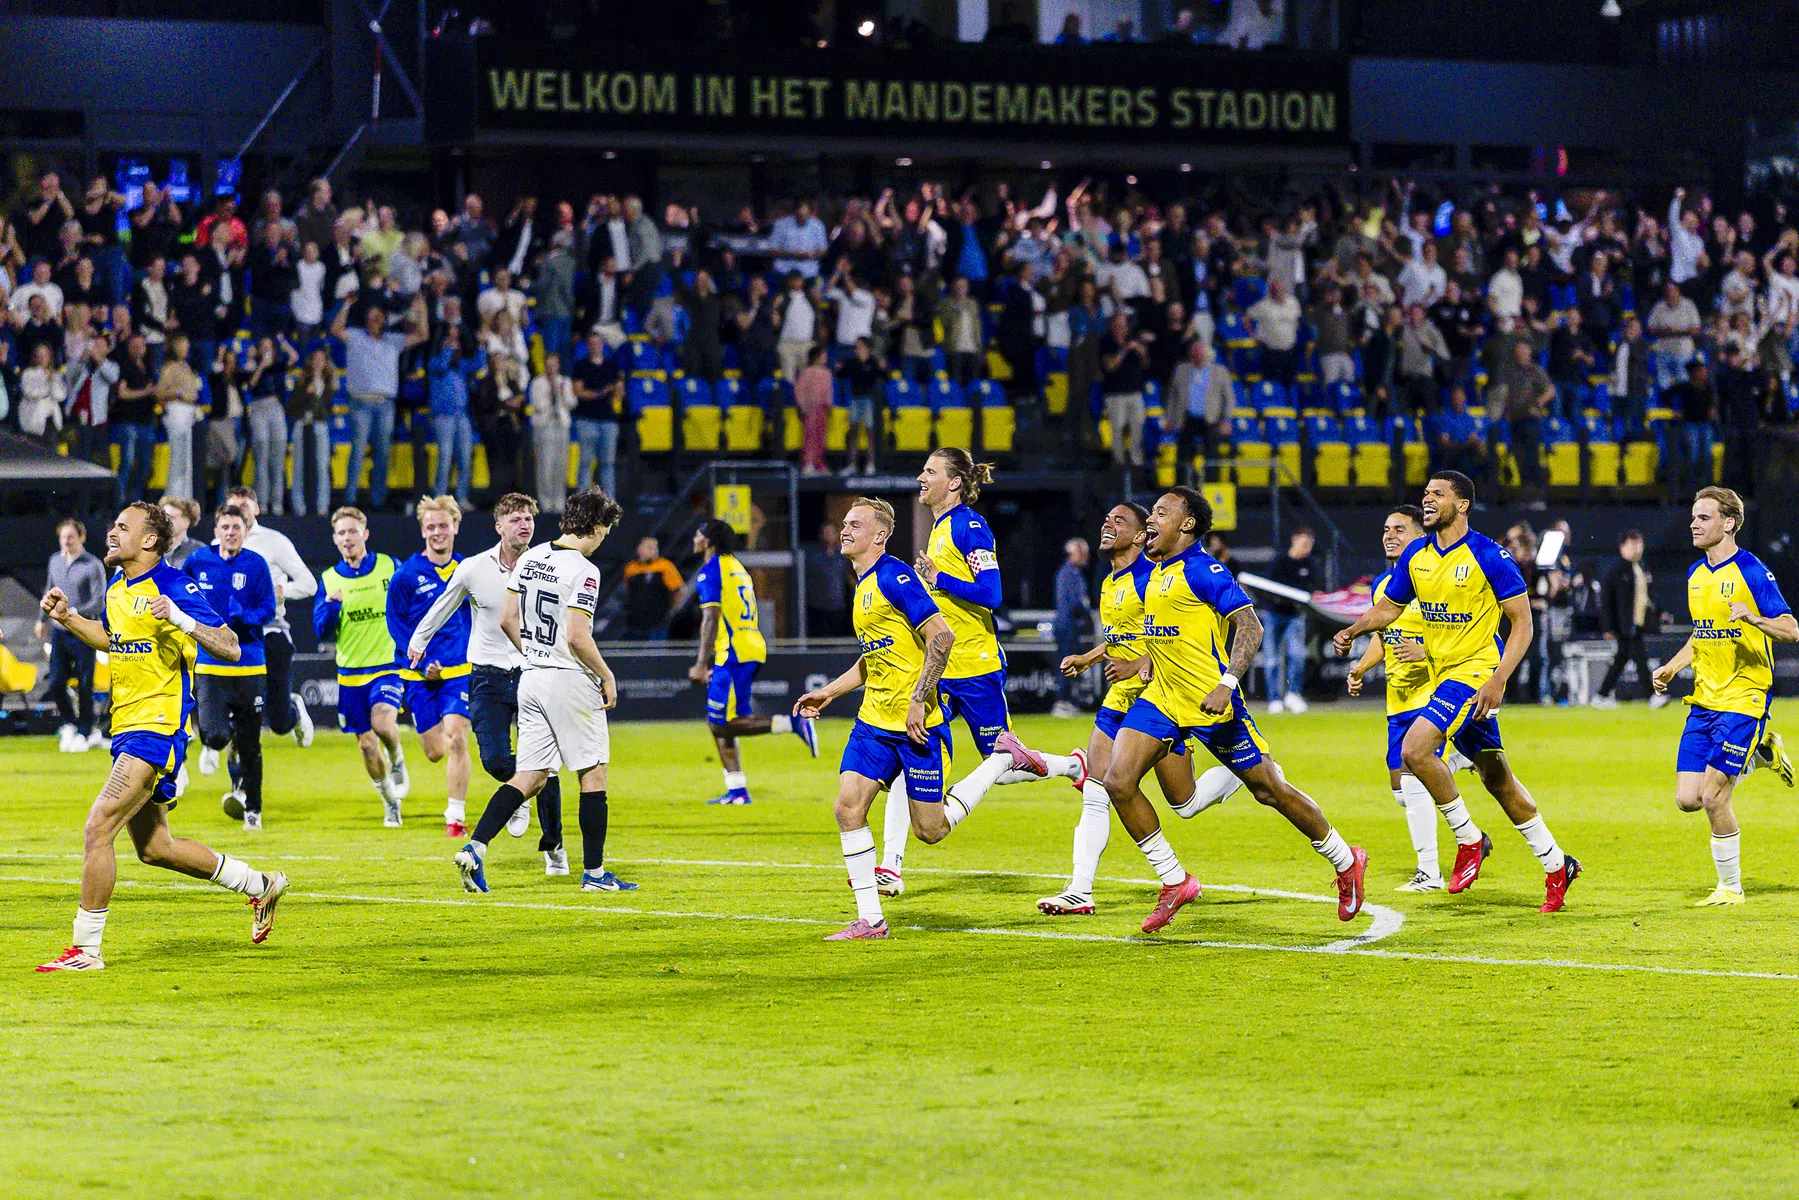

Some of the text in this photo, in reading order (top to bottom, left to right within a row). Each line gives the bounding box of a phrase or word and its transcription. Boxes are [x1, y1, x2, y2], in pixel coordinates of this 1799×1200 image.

[489, 69, 1337, 131] WELKOM IN HET MANDEMAKERS STADION
[518, 583, 558, 646] 15
